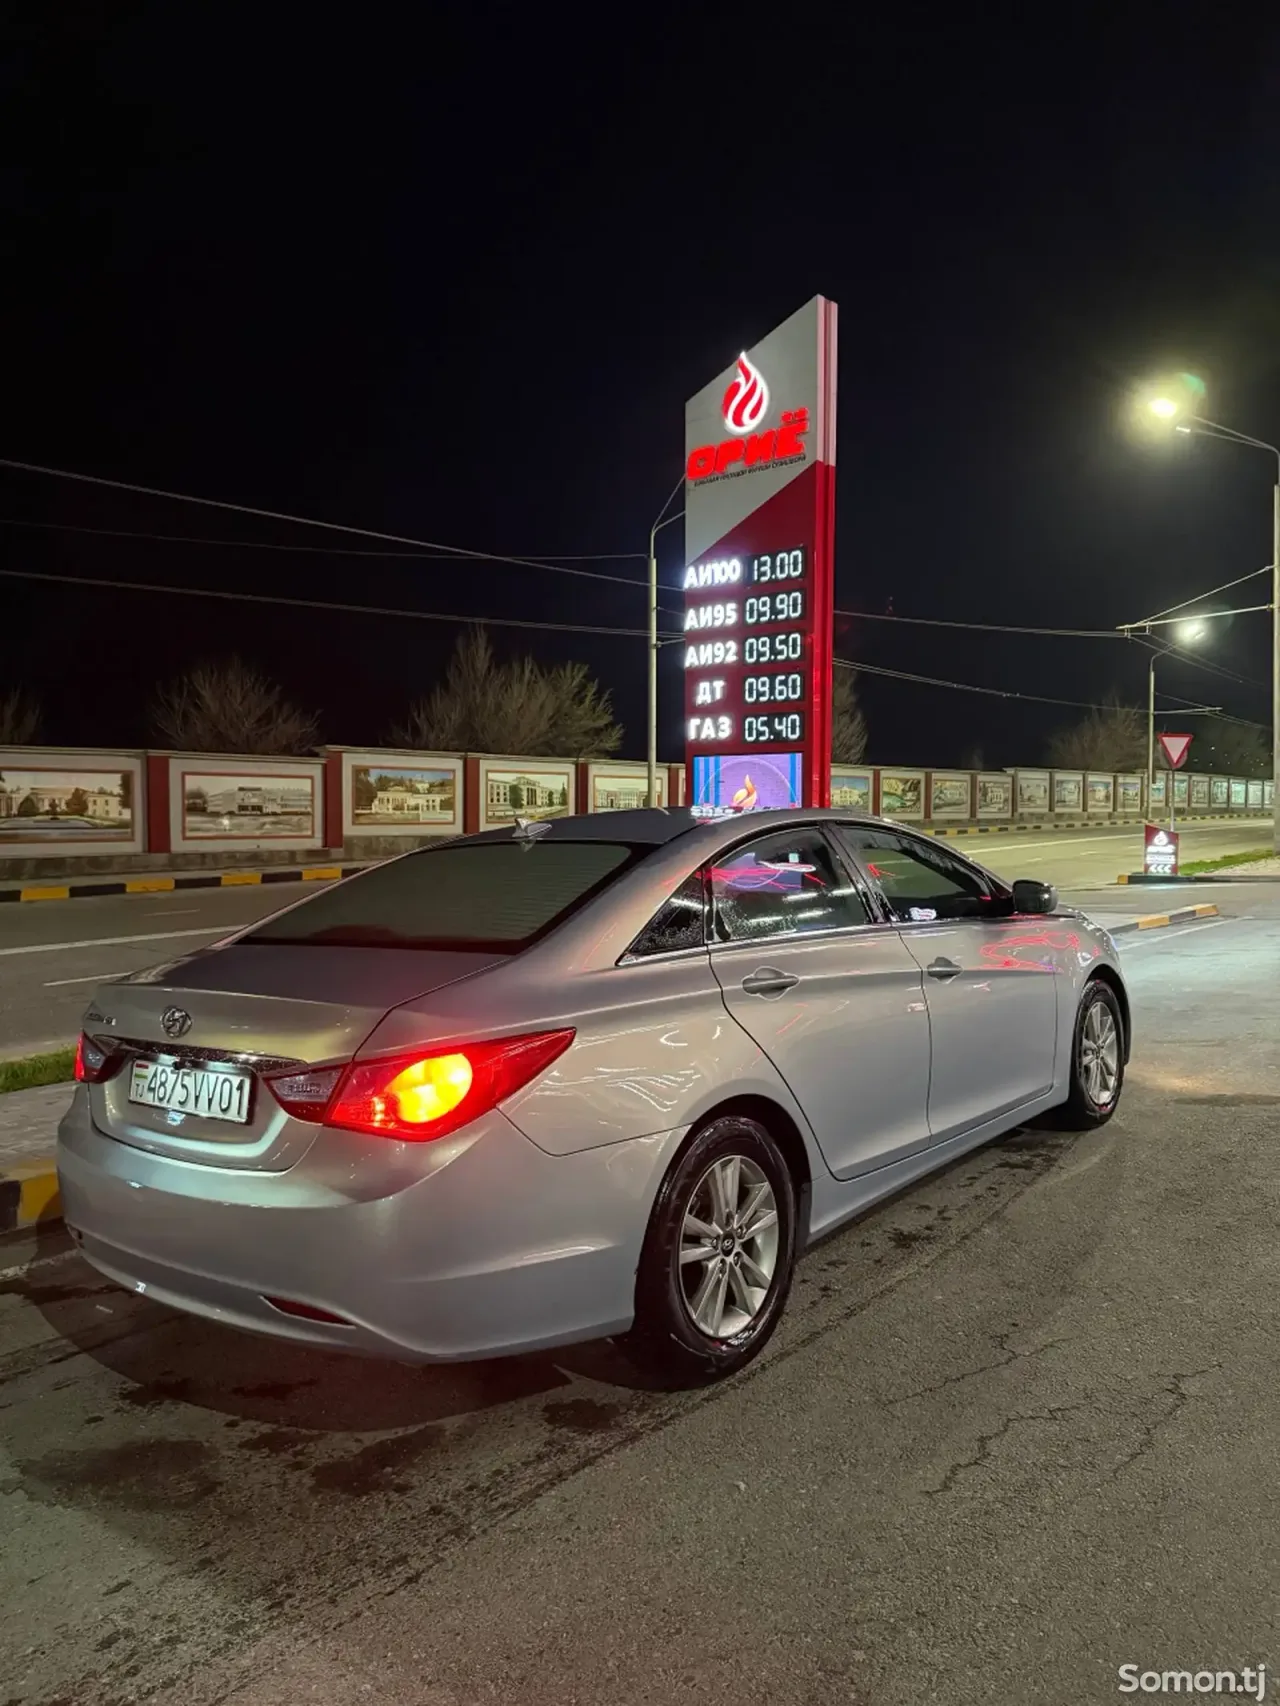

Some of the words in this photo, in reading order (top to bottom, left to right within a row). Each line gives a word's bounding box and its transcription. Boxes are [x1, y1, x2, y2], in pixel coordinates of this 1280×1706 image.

[686, 407, 809, 479] ОРИЁ
[684, 561, 741, 589] АИ100
[753, 551, 802, 583] 13.00
[684, 603, 738, 631] АИ95
[745, 591, 802, 624] 09.90
[684, 641, 738, 668] АИ92
[745, 632, 801, 664] 09.50
[695, 680, 725, 706] ДТ
[745, 673, 801, 703] 09.60
[687, 717, 733, 741] ГАЗ
[745, 714, 800, 742] 05.40
[135, 1083, 145, 1098] TJ
